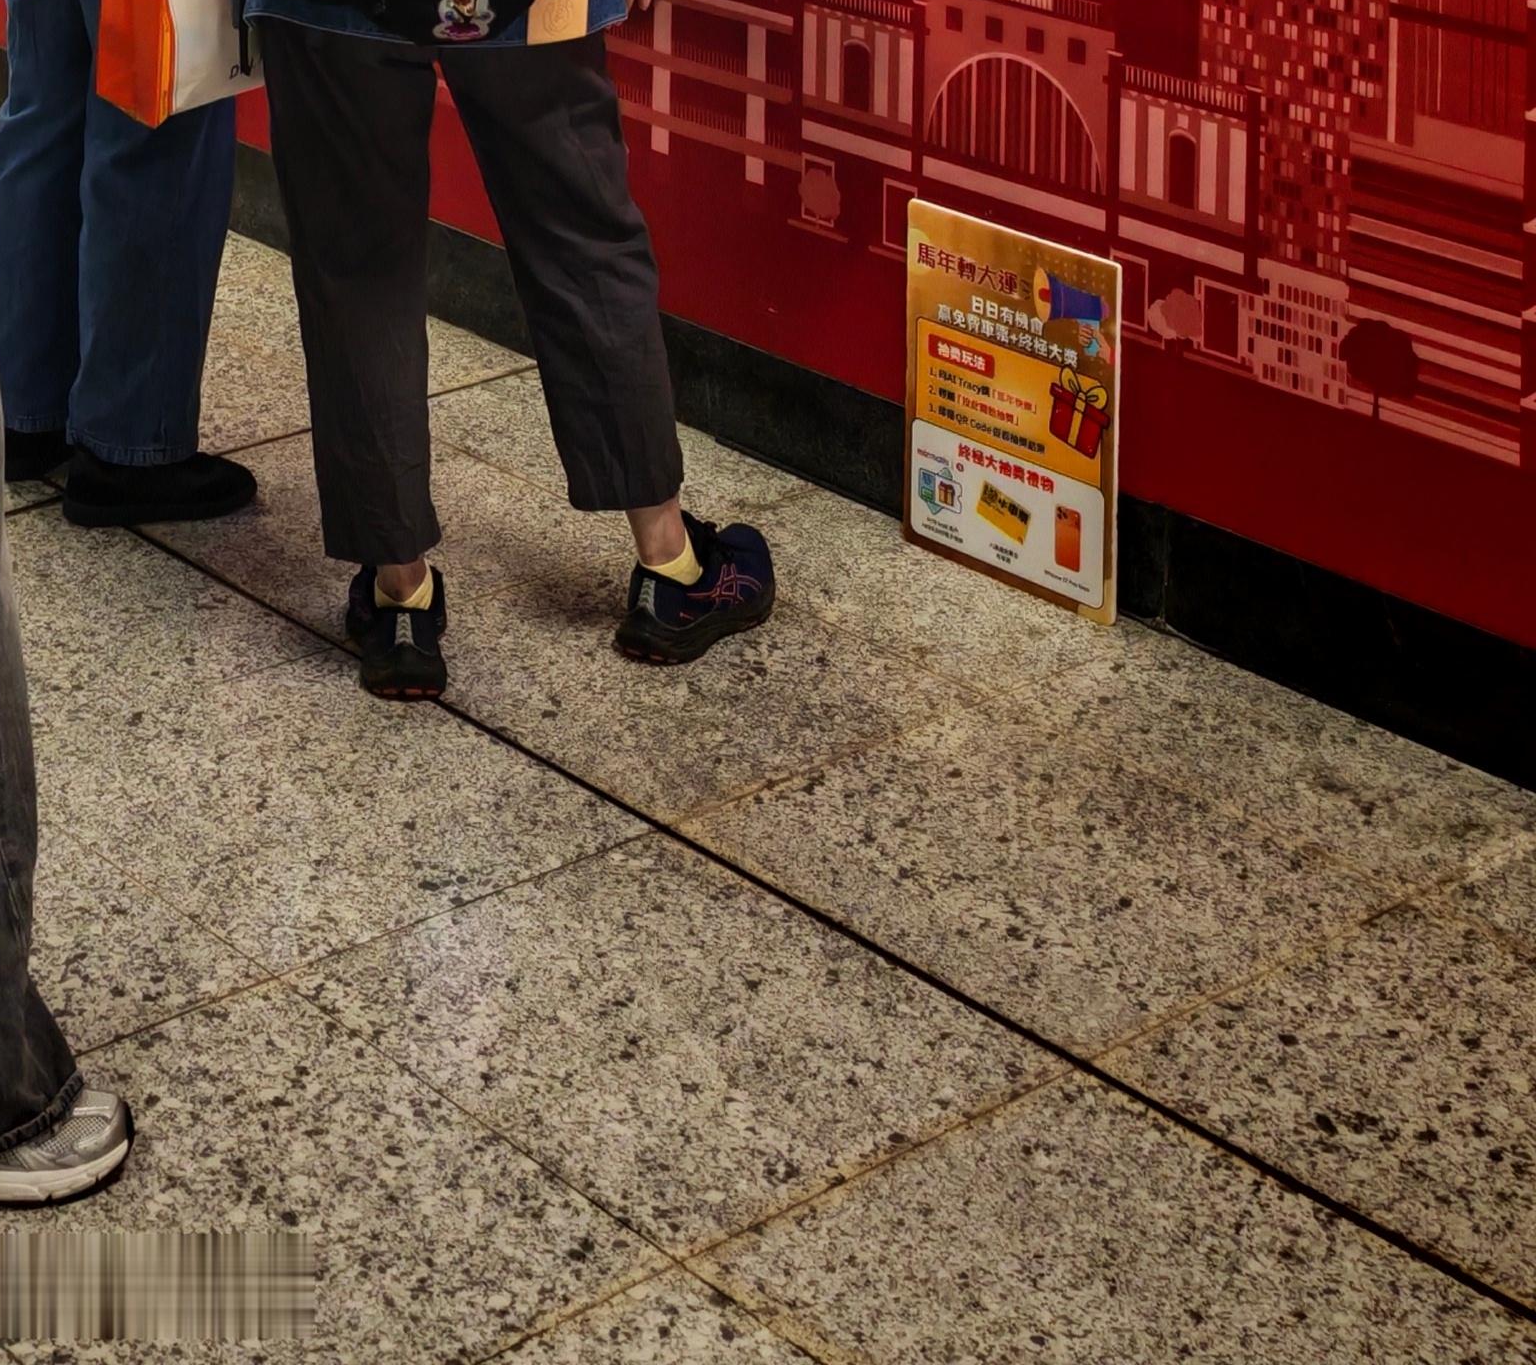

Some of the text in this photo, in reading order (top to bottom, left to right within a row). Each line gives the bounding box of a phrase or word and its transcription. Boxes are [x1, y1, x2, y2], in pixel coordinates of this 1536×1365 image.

[917, 242, 1017, 295] 馬年轉大運
[971, 295, 1043, 336] 日日有機會
